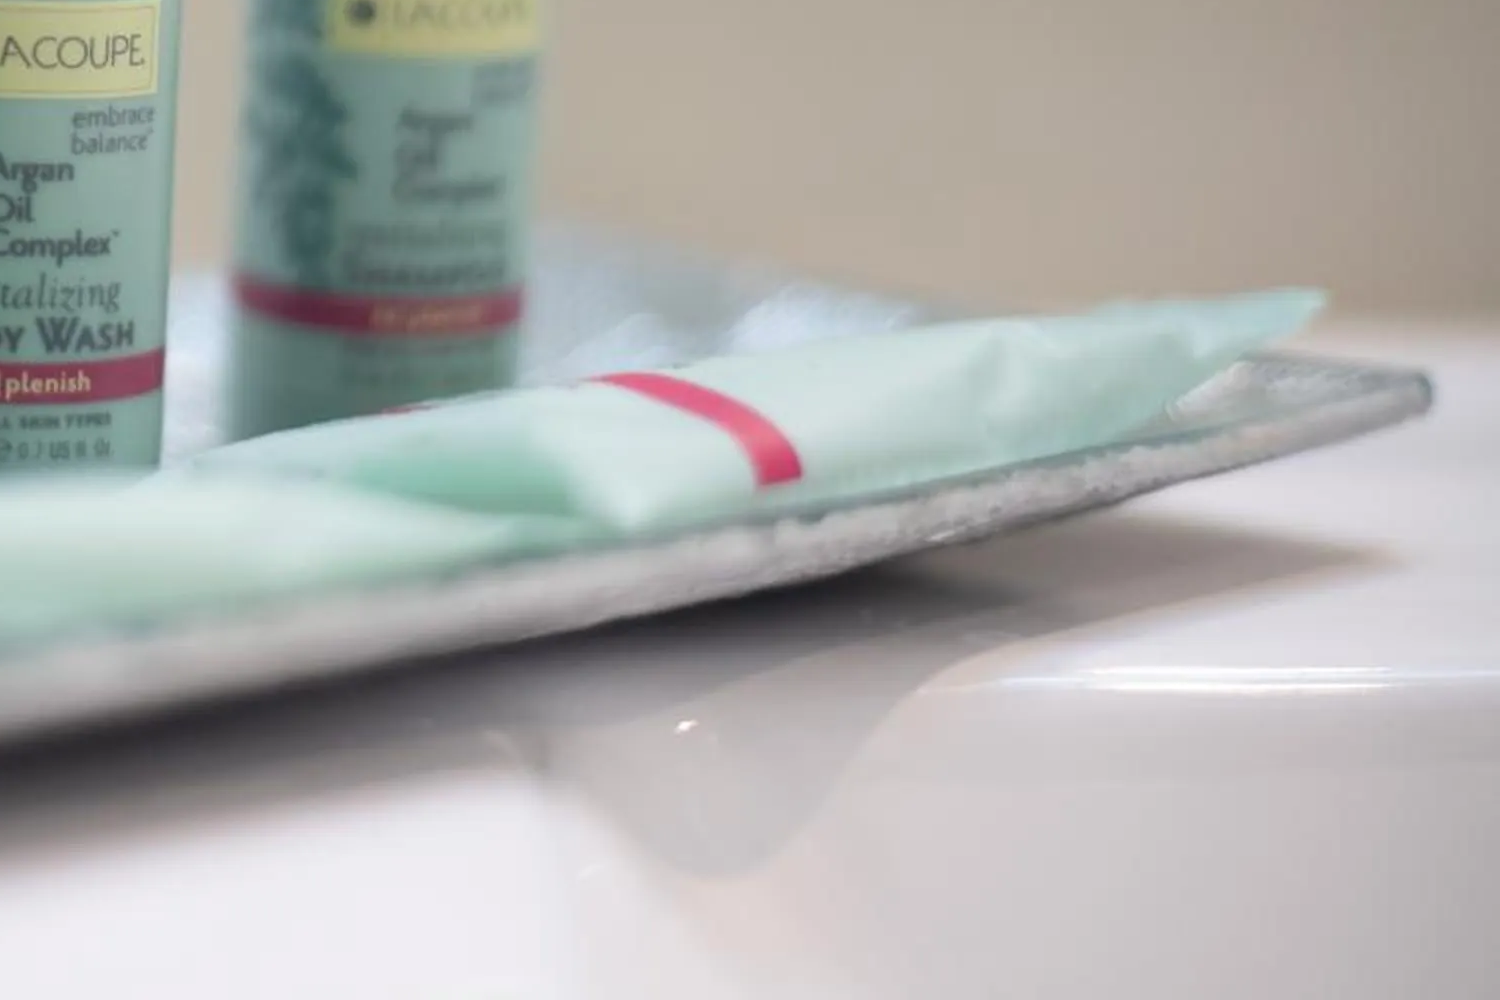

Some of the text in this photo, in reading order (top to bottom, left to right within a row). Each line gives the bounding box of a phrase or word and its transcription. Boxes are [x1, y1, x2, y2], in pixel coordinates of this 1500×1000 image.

[71, 105, 155, 130] embrace
[71, 131, 149, 156] balance
[36, 316, 135, 354] WASH
